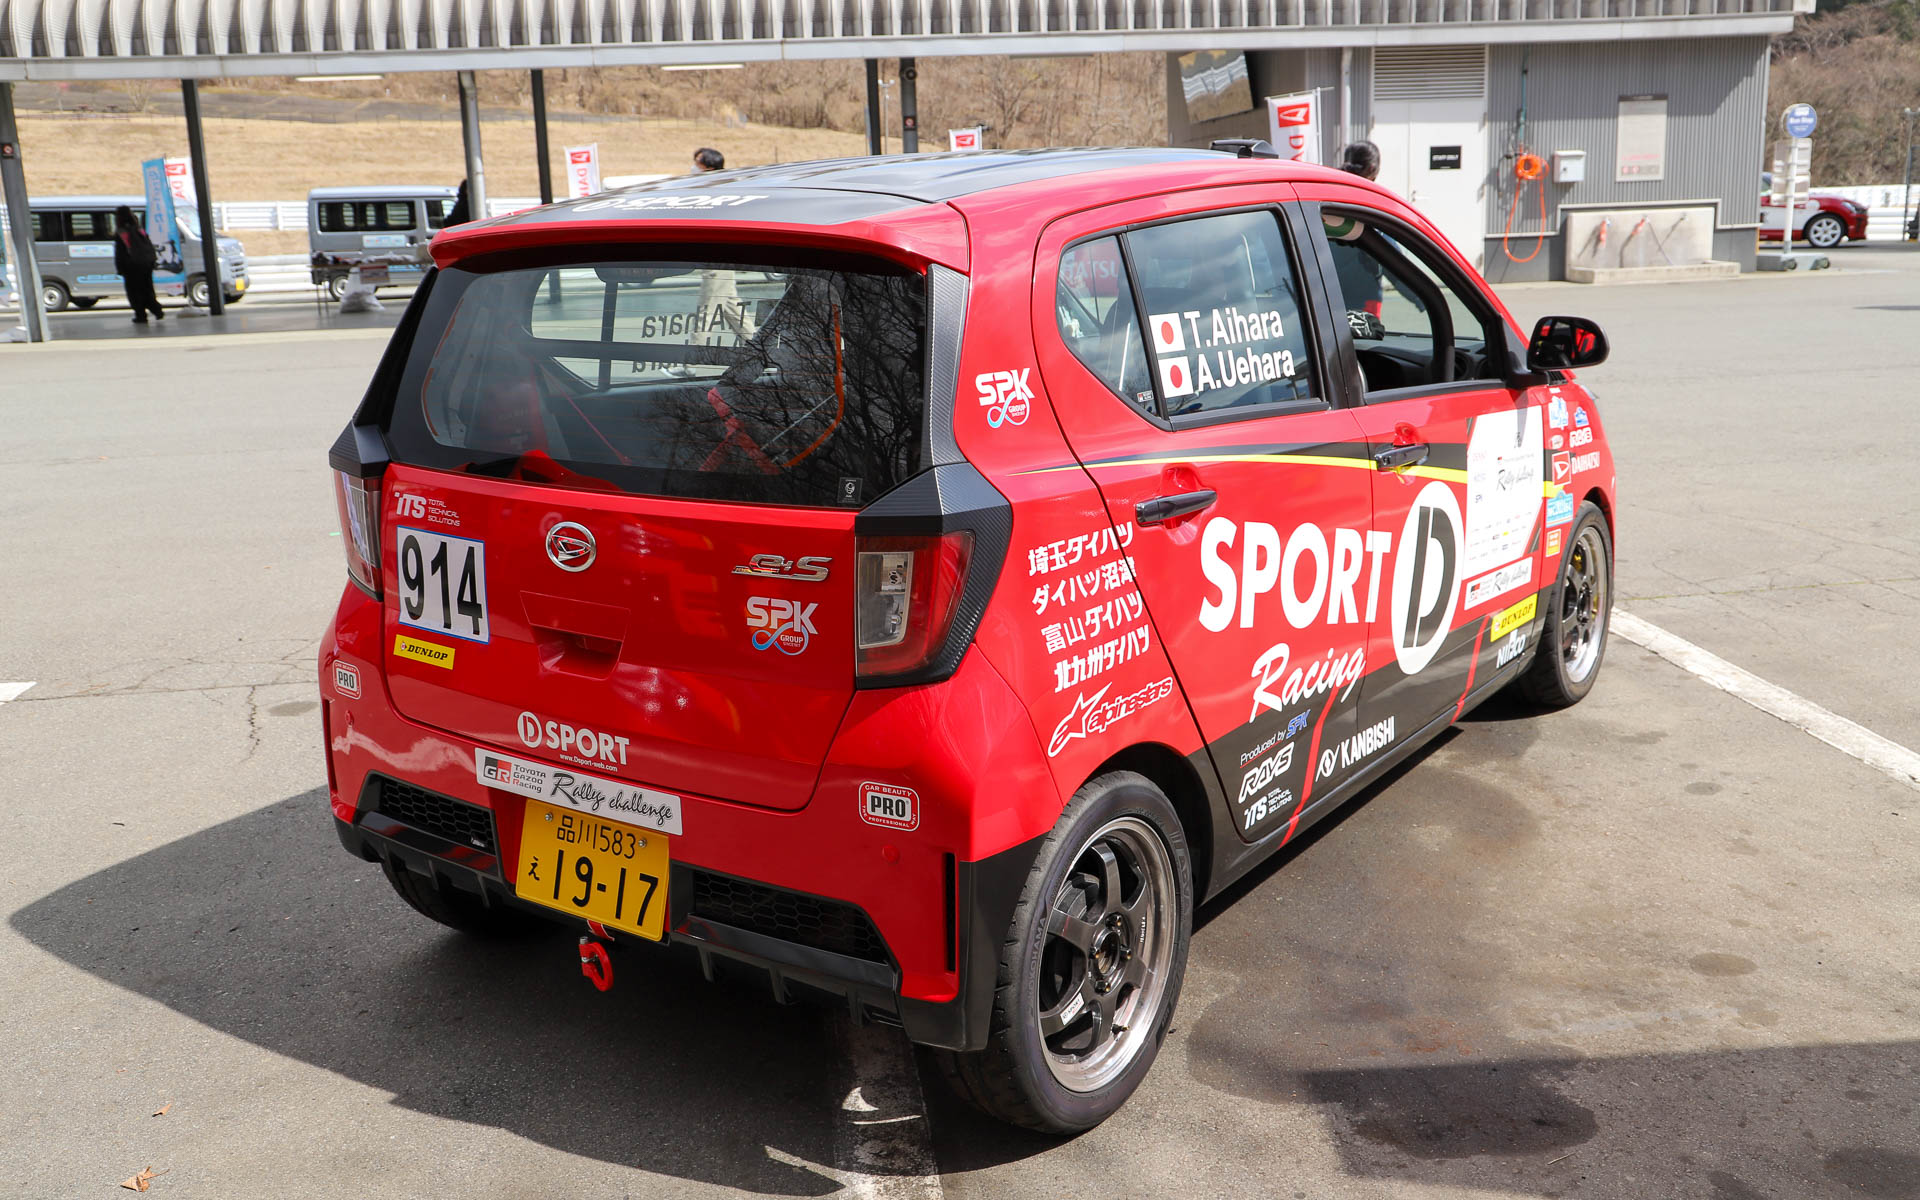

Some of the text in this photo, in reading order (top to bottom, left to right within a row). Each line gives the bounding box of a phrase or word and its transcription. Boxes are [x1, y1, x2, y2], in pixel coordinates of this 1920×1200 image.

[614, 195, 769, 208] SPORT
[975, 368, 1035, 406] SPK
[427, 515, 460, 527] SOLUTIONS
[428, 498, 447, 508] TOTAL
[1028, 521, 1134, 577] 埼玉ダイハツ
[401, 534, 484, 635] 914
[1199, 516, 1393, 632] SPORT
[746, 595, 820, 634] SPK
[1041, 590, 1143, 655] 富山ダイハツ
[1501, 602, 1534, 629] DUNLOP
[407, 644, 449, 661] DUNLOP
[780, 634, 804, 644] GROUP
[1053, 624, 1150, 693] 北九州ダイハツ
[338, 670, 355, 689] PRO
[1249, 642, 1367, 724] Racing
[545, 720, 630, 765] SPORT
[1240, 734, 1277, 766] Produced
[1277, 729, 1287, 742] by
[1340, 715, 1395, 769] KANBISHI
[513, 763, 547, 778] TOYOTA
[513, 771, 544, 785] GAZOO
[559, 753, 618, 772] www.Dsport-web.com
[1238, 741, 1295, 804] RAYS
[513, 778, 543, 794] Racing
[551, 772, 673, 827] Rally challenge
[865, 784, 913, 798] CAR BEAUTY
[871, 795, 907, 818] PRO
[528, 849, 660, 927] え 19-17
